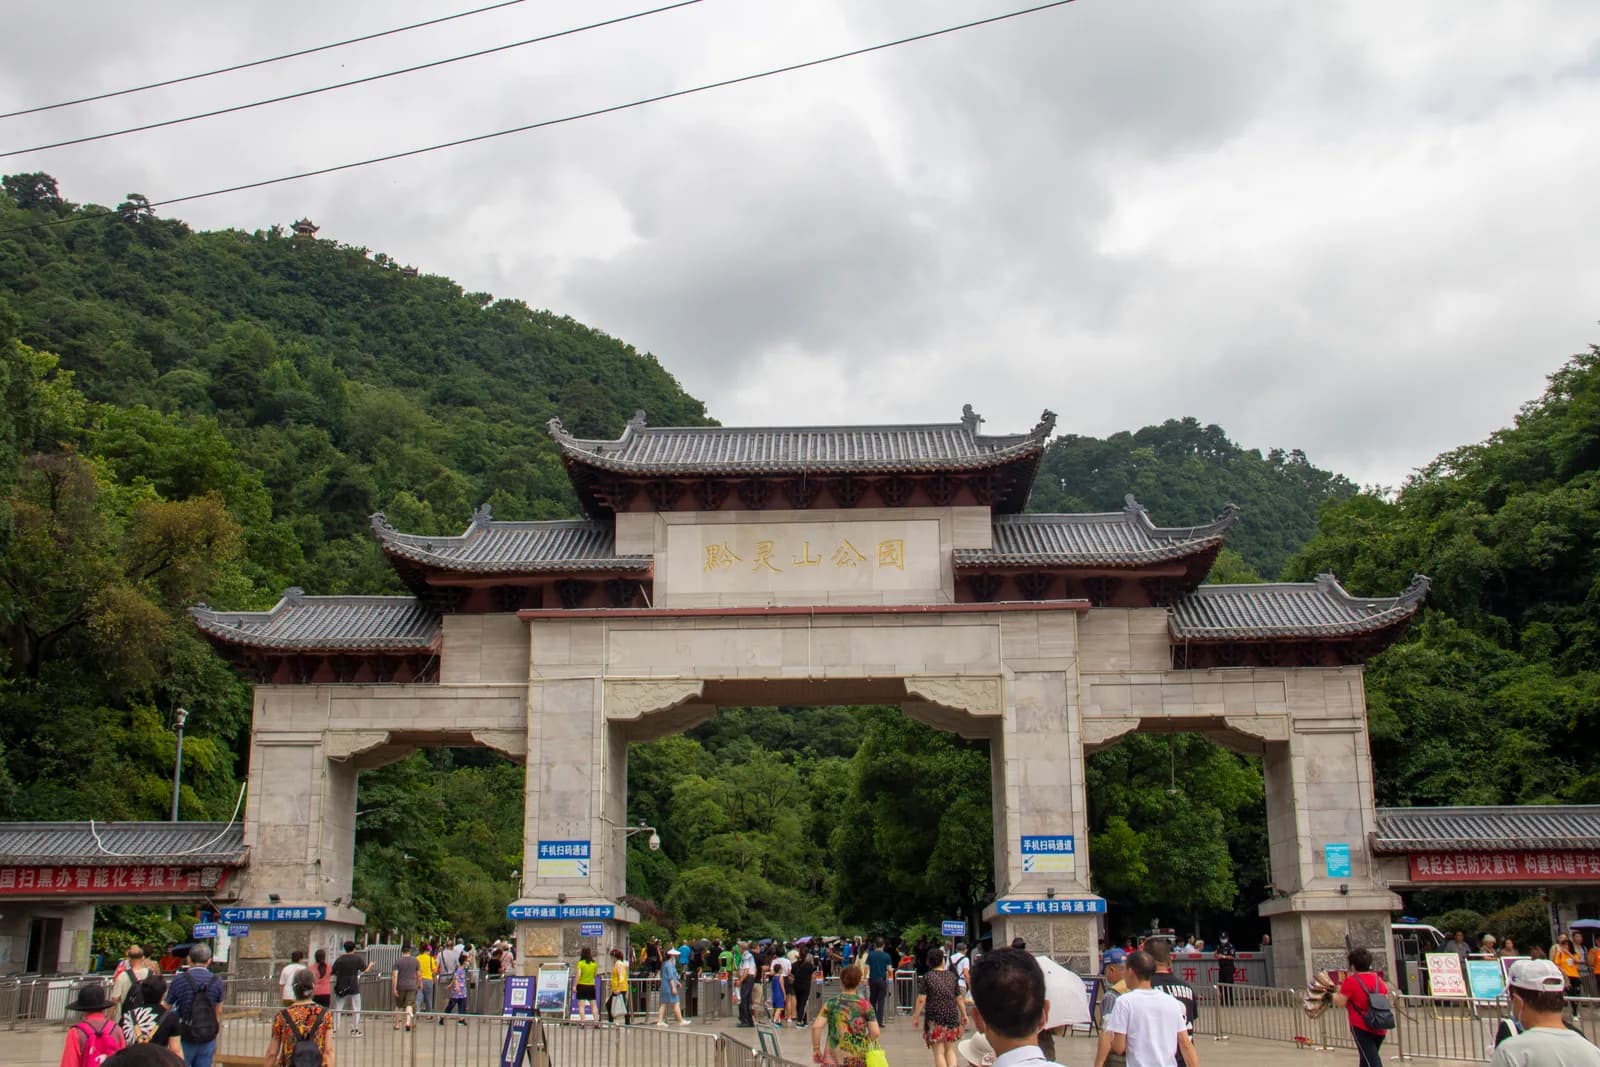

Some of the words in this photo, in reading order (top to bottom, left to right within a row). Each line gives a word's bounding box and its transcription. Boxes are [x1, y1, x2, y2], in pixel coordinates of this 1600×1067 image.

[703, 537, 905, 574] 黔灵山公园
[540, 844, 589, 857] 手机扫码通道
[1023, 839, 1073, 852] 手机扫码通道
[1416, 854, 1519, 875] 唤起全民防灾意识
[524, 907, 557, 917] 证件通道
[562, 907, 601, 917] 手机扫码通道
[1023, 901, 1097, 913] 手机扫码通道
[276, 909, 309, 919] 证件通道
[1168, 967, 1248, 984] 开门红
